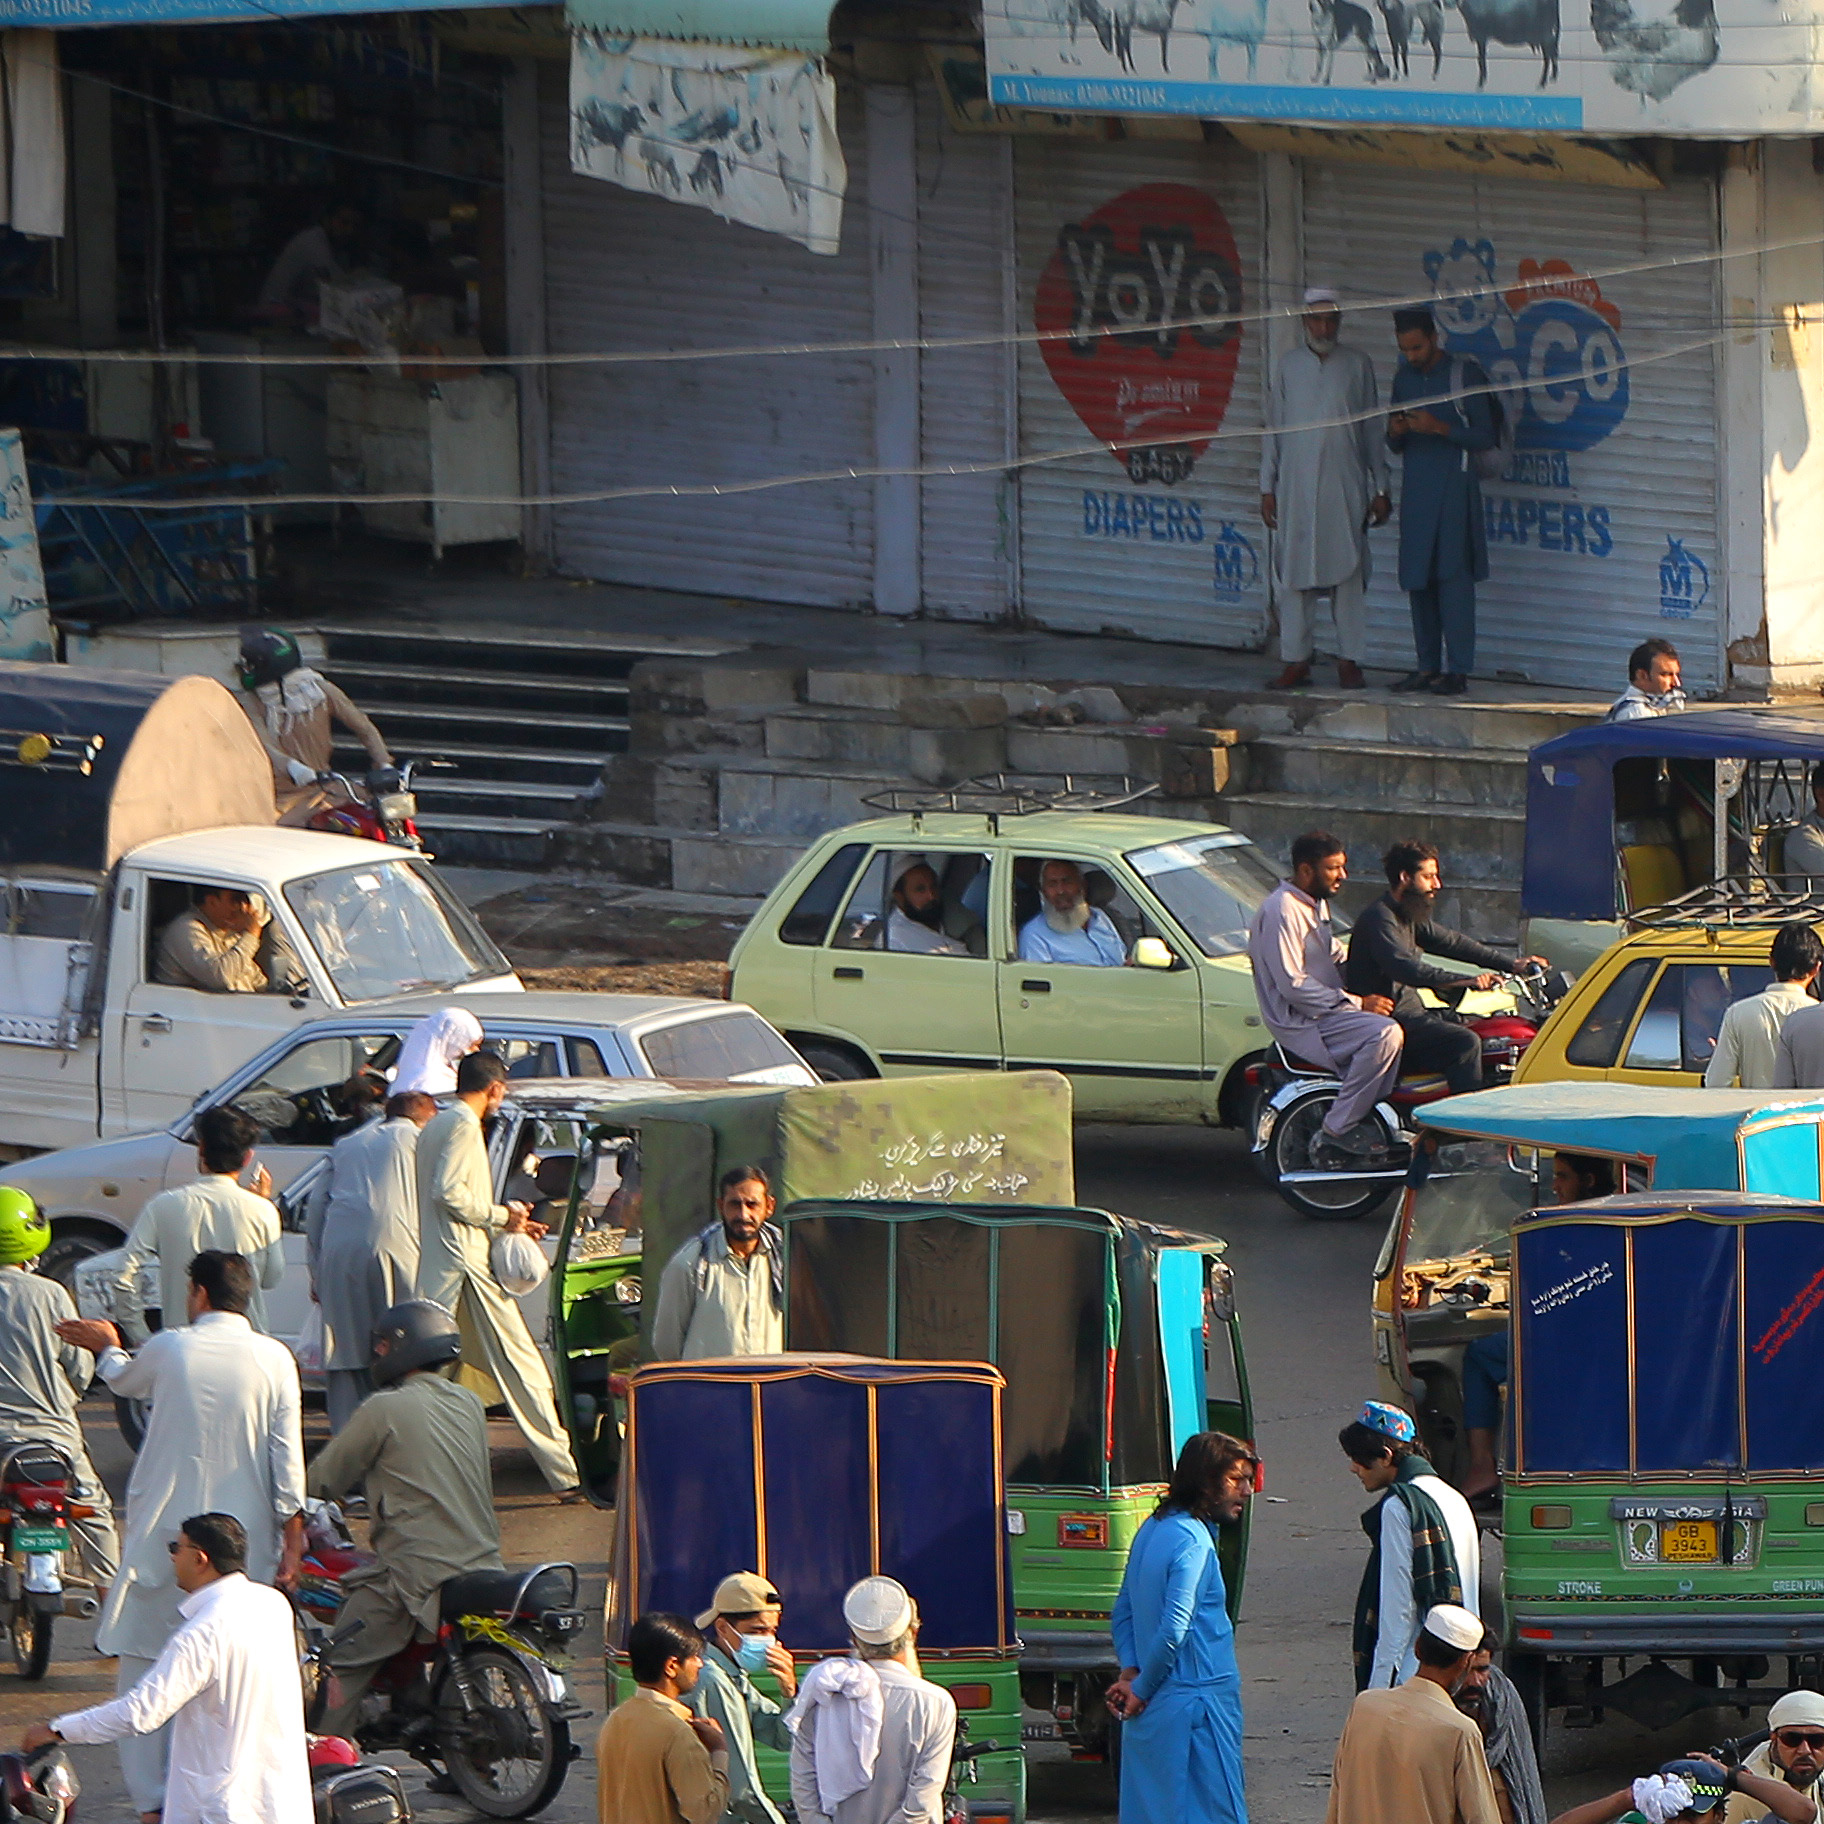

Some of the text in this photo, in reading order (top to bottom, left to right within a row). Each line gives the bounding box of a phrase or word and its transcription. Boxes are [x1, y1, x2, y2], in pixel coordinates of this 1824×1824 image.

[1083, 489, 1205, 544] DIAPERS
[1624, 1507, 1659, 1518] NEW
[1678, 1524, 1700, 1539] GB
[1671, 1539, 1708, 1553] 3943
[1558, 1581, 1602, 1594] STROKE
[1772, 1579, 1804, 1593] GREEN
